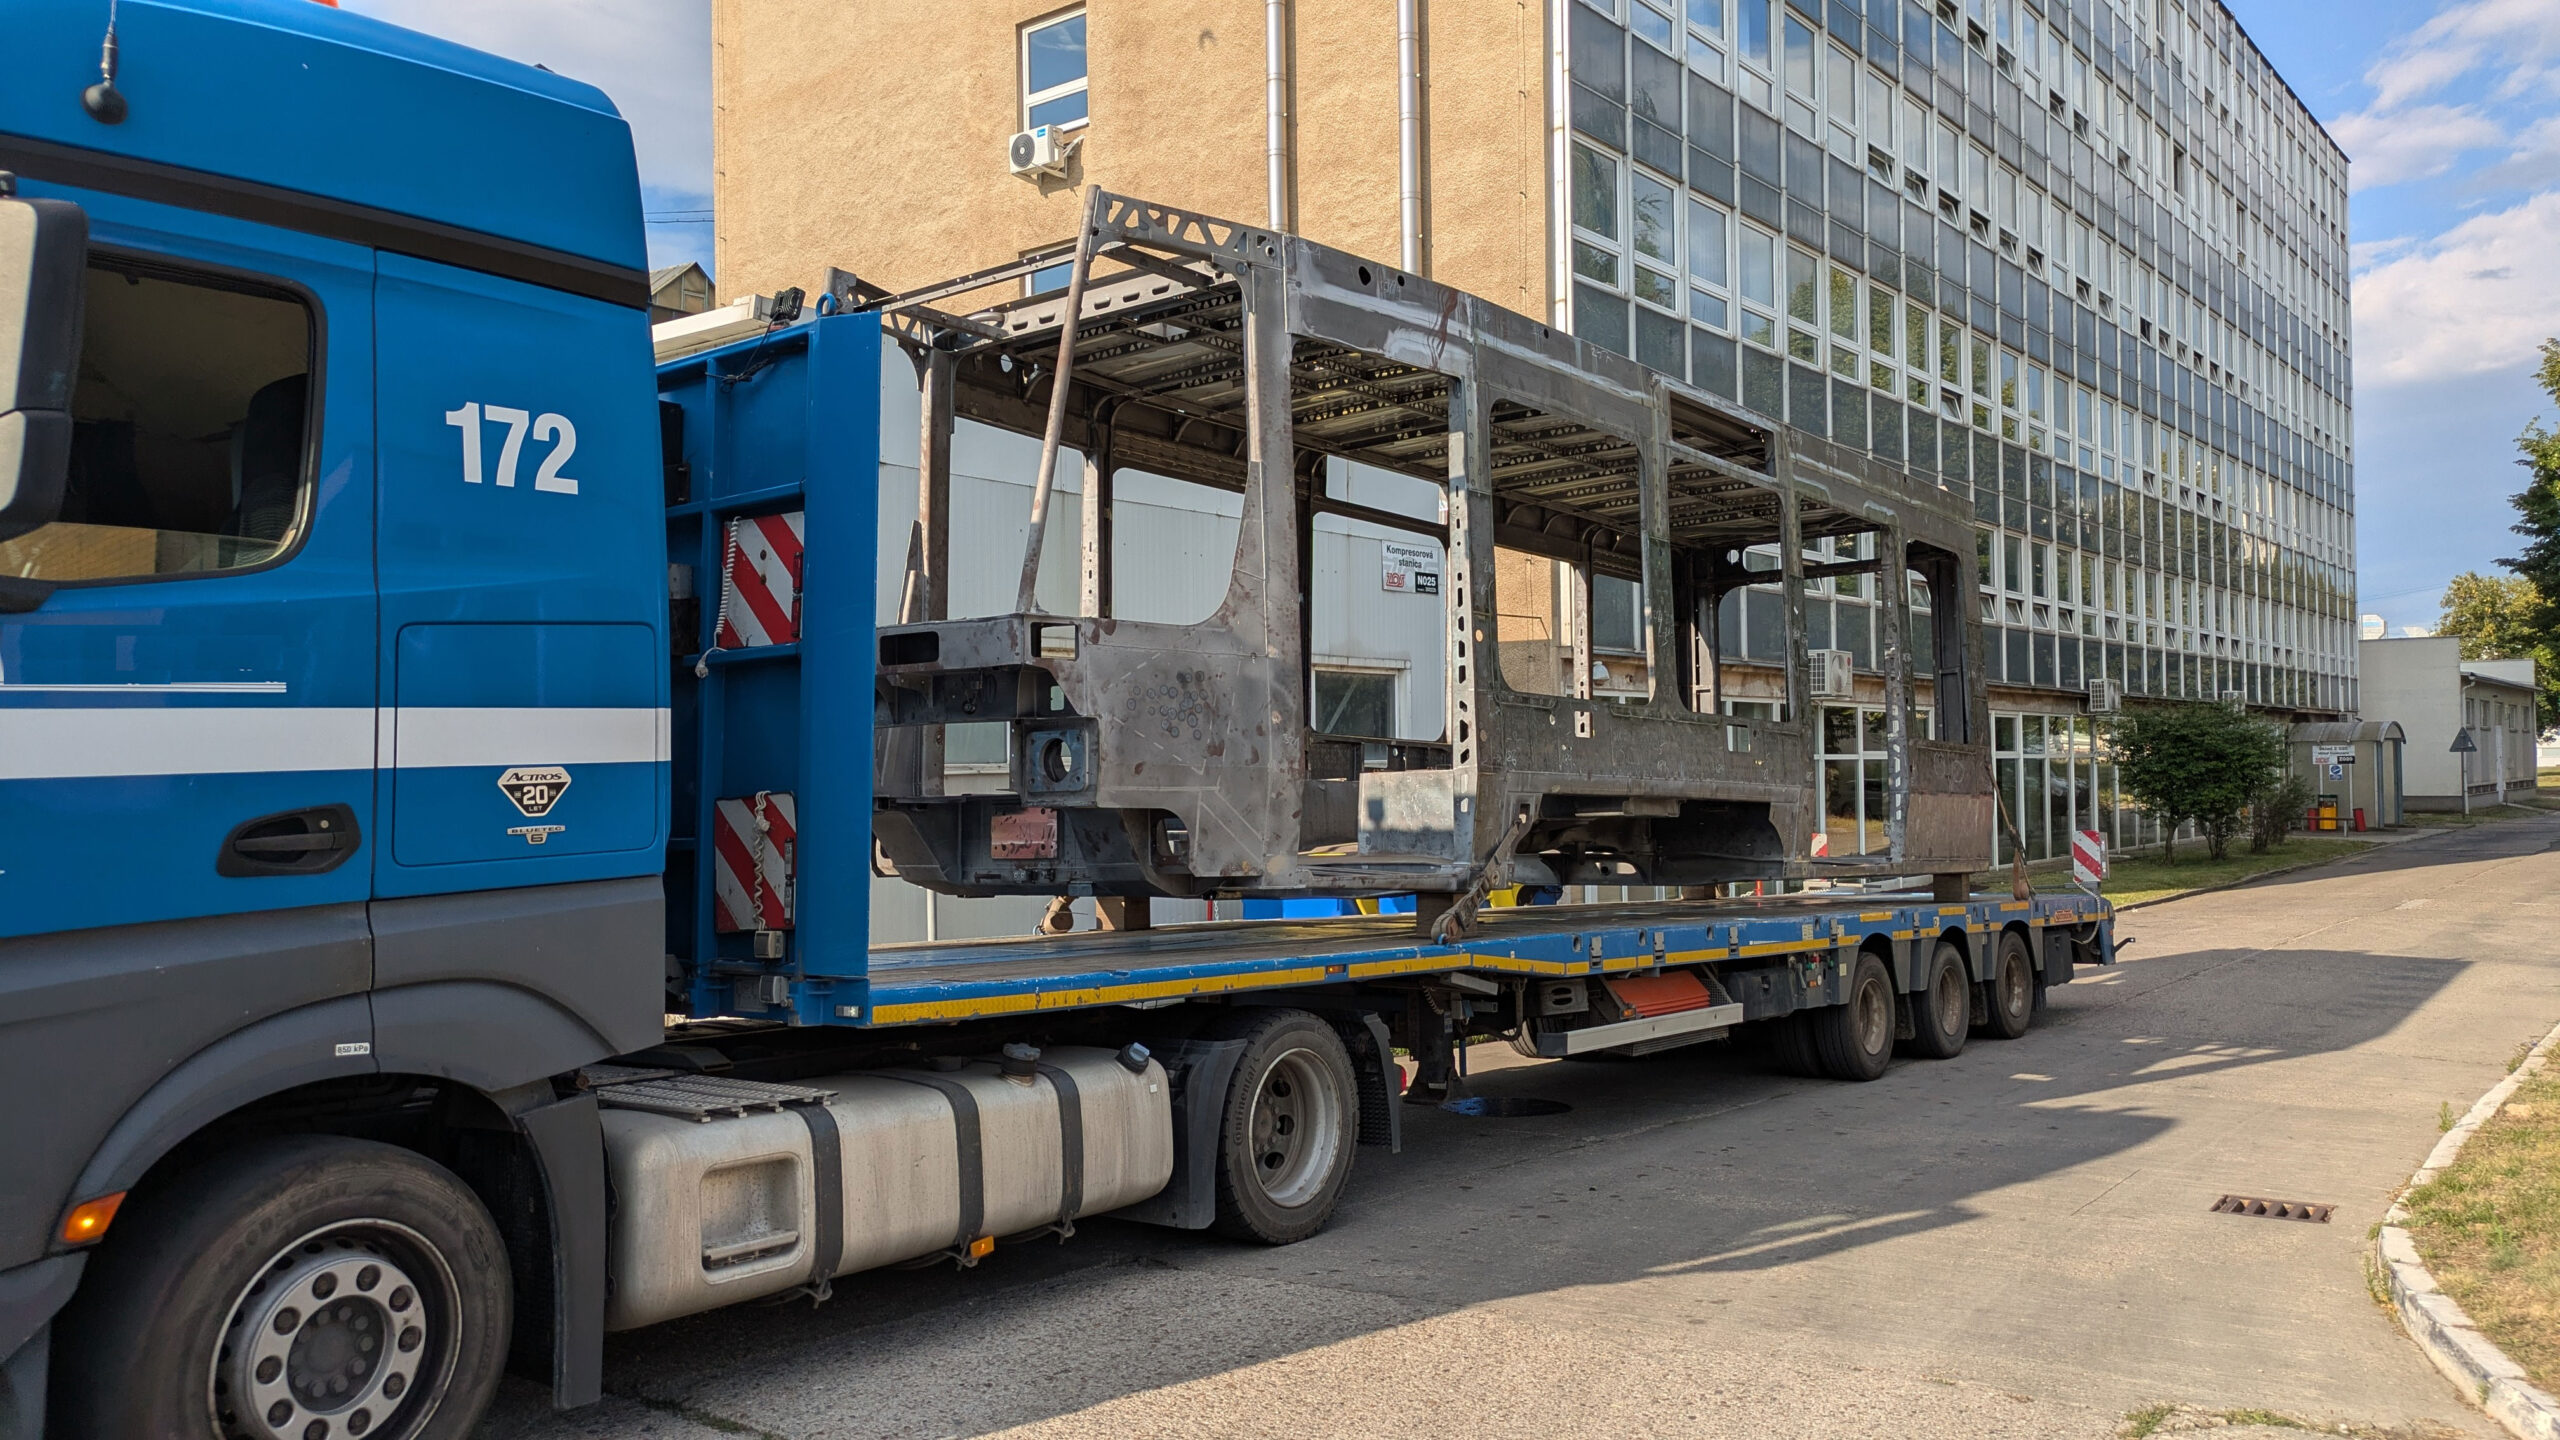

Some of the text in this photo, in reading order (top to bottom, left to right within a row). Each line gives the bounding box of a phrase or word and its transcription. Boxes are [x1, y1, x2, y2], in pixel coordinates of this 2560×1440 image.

[446, 402, 578, 495] 172
[1386, 544, 1434, 559] Kompresorová
[1398, 559, 1422, 569] stanica
[522, 785, 549, 805] 20
[511, 826, 562, 834] BLUETEC
[530, 833, 544, 843] 6
[353, 1044, 369, 1053] kPa
